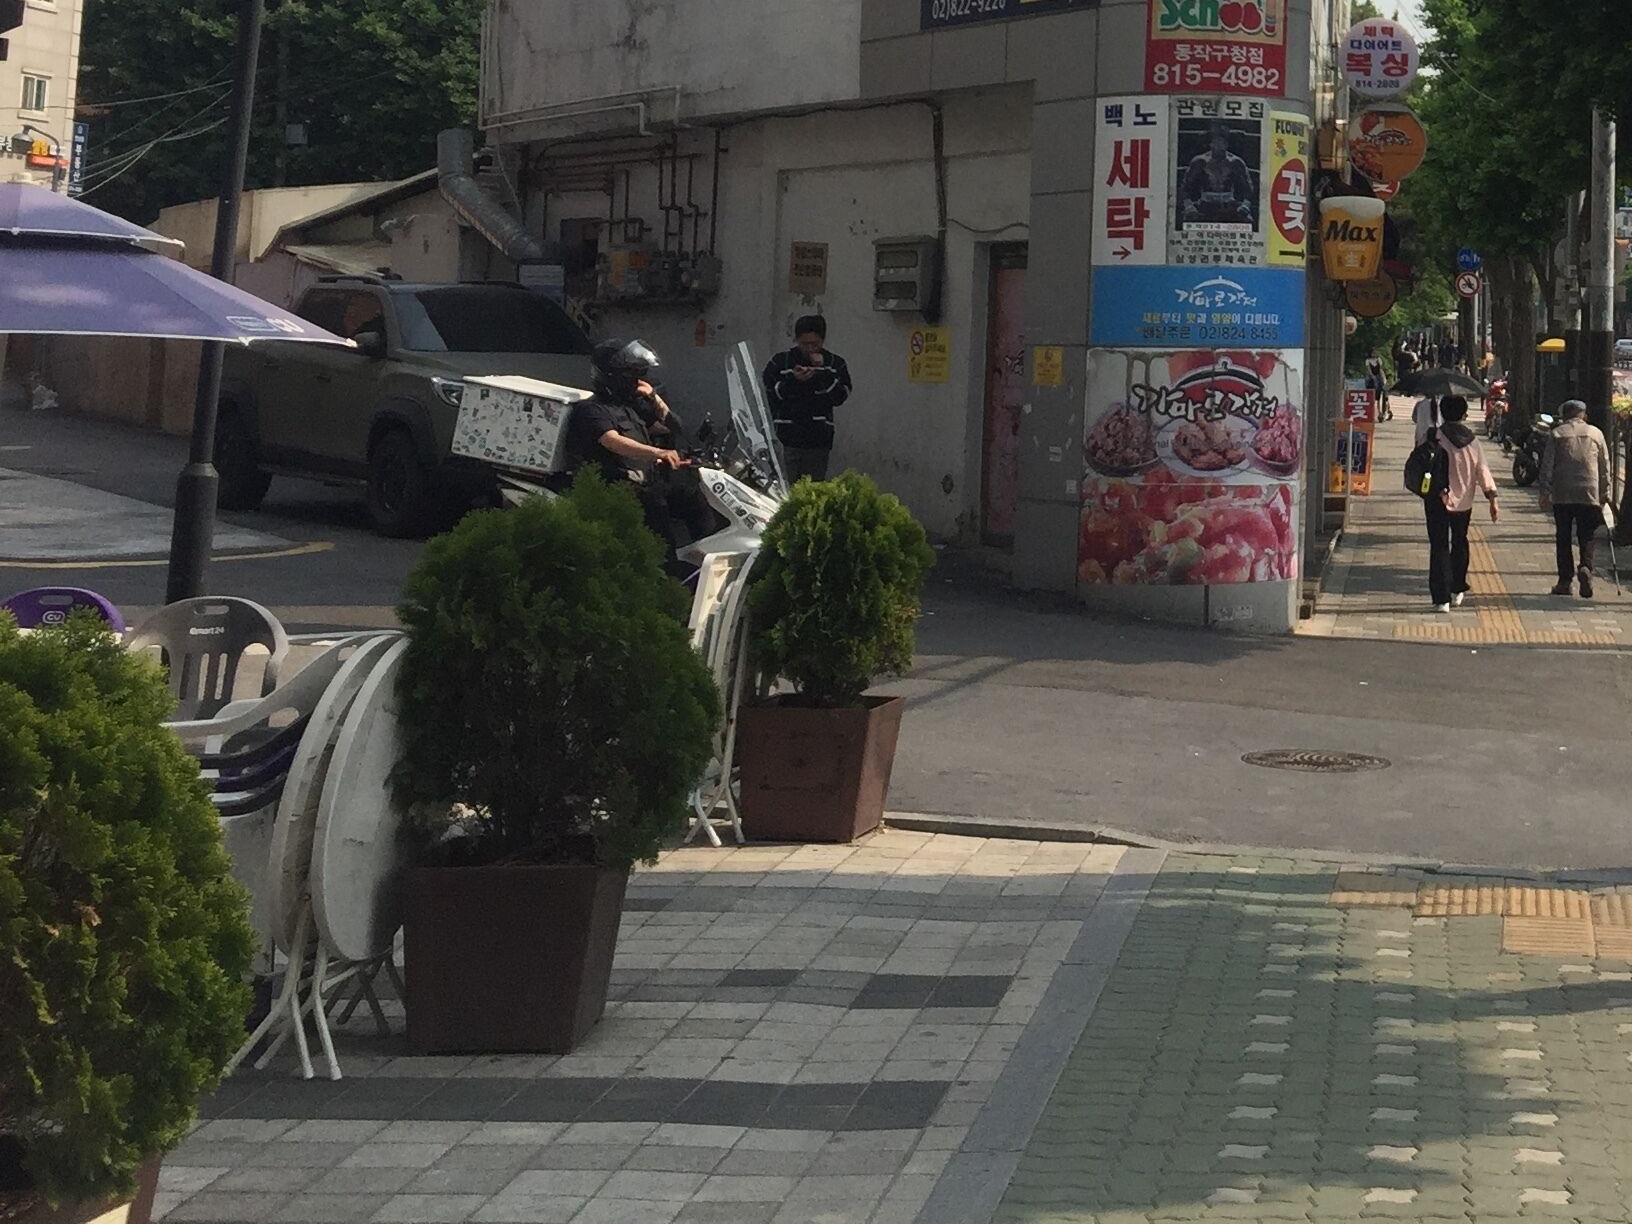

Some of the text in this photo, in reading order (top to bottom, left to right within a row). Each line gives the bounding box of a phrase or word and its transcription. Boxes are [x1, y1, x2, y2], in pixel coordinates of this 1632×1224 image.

[1173, 44, 1264, 64] 동작구청점
[1346, 52, 1410, 78] 복싱
[1153, 63, 1280, 89] 815-4982
[1176, 99, 1264, 119] 관원모집
[1106, 138, 1151, 251] 세탁
[1323, 219, 1378, 242] Max
[1132, 383, 1279, 423] 가마로강정
[1347, 392, 1370, 419] 꽃
